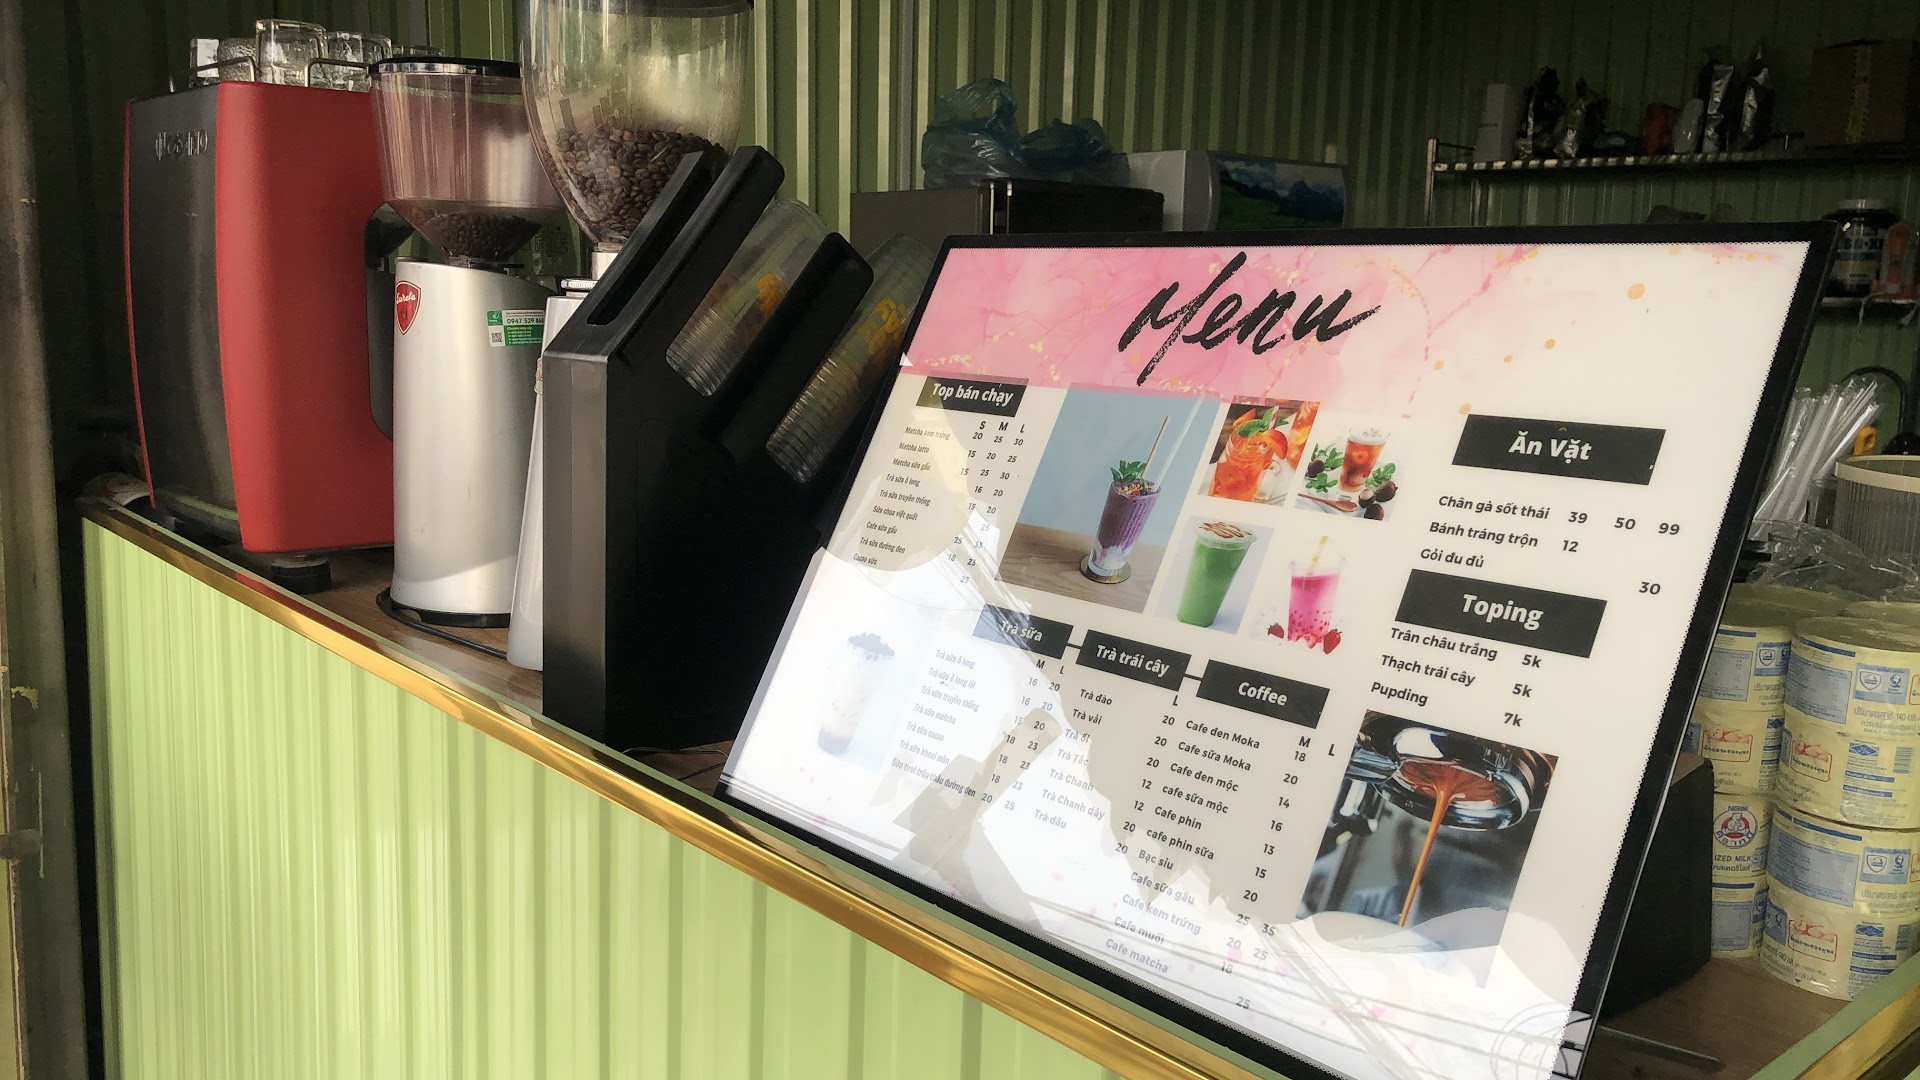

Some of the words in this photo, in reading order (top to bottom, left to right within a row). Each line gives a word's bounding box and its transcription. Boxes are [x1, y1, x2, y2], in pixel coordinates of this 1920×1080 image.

[1118, 251, 1381, 386] Menu
[931, 382, 954, 401] Top
[954, 384, 980, 400] bán
[980, 387, 1014, 407] chạy
[903, 425, 923, 436] Matcha
[971, 431, 984, 440] 20
[992, 435, 1004, 443] 25
[1012, 437, 1024, 446] 30
[978, 420, 986, 430] S
[997, 421, 1009, 431] M
[897, 441, 917, 452] Matcha
[967, 449, 977, 458] 15
[985, 451, 997, 460] 20
[1006, 454, 1017, 463] 25
[1507, 430, 1543, 456] Ăn
[1550, 438, 1592, 464] Vặt
[891, 457, 911, 468] Matcha
[959, 467, 970, 476] 15
[979, 468, 990, 477] 25
[999, 471, 1010, 480] 30
[967, 502, 976, 511] 15
[985, 505, 997, 514] 20
[973, 485, 983, 494] 16
[992, 488, 1004, 497] 20
[1438, 495, 1474, 510] Chân
[1474, 500, 1493, 514] gà
[1494, 502, 1518, 515] sốt
[1520, 505, 1551, 520] thái
[1567, 510, 1588, 524] 39
[1613, 516, 1636, 530] 50
[1657, 522, 1680, 536] 99
[1428, 521, 1465, 537] Bánh
[1466, 527, 1506, 545] tráng
[1507, 532, 1539, 548] trộn
[1562, 539, 1579, 553] 12
[1419, 547, 1444, 562] Gỏi
[1444, 551, 1463, 565] đu
[1464, 554, 1485, 568] đủ
[1638, 581, 1661, 595] 30
[1000, 619, 1019, 635] Trà
[1019, 623, 1043, 642] sữa
[1462, 593, 1544, 631] Toping
[1035, 658, 1046, 669] M
[1096, 644, 1117, 661] Trà
[1118, 651, 1145, 668] trái
[1144, 658, 1170, 678] cây
[1390, 627, 1420, 643] Trân
[1421, 634, 1456, 651] châu
[1521, 653, 1542, 669] 5k
[1027, 676, 1038, 687] 16
[1047, 681, 1061, 692] 20
[1237, 681, 1287, 706] Coffee
[1381, 654, 1421, 673] Thạch
[1423, 663, 1449, 679] trái
[1449, 670, 1476, 687] cây
[1511, 682, 1532, 698] 5k
[1020, 695, 1031, 706] 16
[1040, 700, 1053, 711] 20
[1079, 688, 1094, 701] Trà
[1094, 693, 1113, 706] đào
[1161, 714, 1175, 726] 20
[1370, 681, 1428, 707] Pupding
[1503, 711, 1523, 727] 7k
[1005, 733, 1016, 745] 18
[1026, 740, 1039, 751] 23
[1013, 715, 1023, 726] 15
[1032, 720, 1045, 731] 20
[1072, 708, 1086, 720] Trà
[1087, 713, 1103, 725] vải
[1153, 735, 1168, 747] 20
[1185, 719, 1208, 734] Cafe
[1209, 726, 1230, 740] đen
[1230, 732, 1260, 749] Moka
[1293, 750, 1306, 762] 18
[1297, 735, 1311, 748] M
[998, 753, 1008, 764] 18
[1019, 760, 1031, 771] 23
[1064, 728, 1079, 741] Trà
[1145, 756, 1160, 768] 20
[1177, 741, 1200, 755] Cafe
[1201, 749, 1221, 762] sữa
[1222, 754, 1251, 771] Moka
[1282, 772, 1298, 785] 20
[990, 773, 1001, 784] 18
[1057, 747, 1072, 761] Trà
[1141, 778, 1152, 790] 12
[1169, 762, 1193, 777] Cafe
[1193, 770, 1214, 784] đen
[1214, 778, 1239, 792] mộc
[1277, 796, 1290, 809] 14
[980, 792, 993, 804] 20
[1049, 767, 1064, 781] Trà
[1064, 774, 1094, 792] Chanh
[1133, 799, 1144, 812] 12
[1161, 785, 1183, 799] cafe
[1184, 792, 1204, 806] sữa
[1204, 799, 1229, 814] mộc
[1269, 819, 1283, 832] 16
[1041, 788, 1056, 802] Trà
[1056, 794, 1086, 813] Chanh
[1086, 805, 1106, 821] dây
[1122, 820, 1136, 833] 20
[1033, 808, 1049, 822] Trà
[1048, 815, 1067, 829] dâu
[1114, 842, 1128, 854] 20
[1154, 805, 1177, 821] Cafe
[1176, 815, 1202, 830] phin
[1262, 843, 1275, 855] 13
[1145, 829, 1168, 842] cafe
[1167, 837, 1193, 852] phin
[1193, 846, 1214, 860] sữa
[1254, 866, 1267, 879] 15
[1137, 849, 1157, 864] Bạc
[1242, 889, 1258, 903] 20
[1130, 871, 1152, 888] Cafe
[1153, 882, 1173, 896] sữa
[1235, 913, 1250, 926] 25
[1261, 922, 1276, 937] 35
[1113, 916, 1136, 933] Cafe
[1121, 893, 1144, 910] Cafe
[1144, 900, 1169, 921] kem
[1170, 913, 1202, 936] trứng
[1225, 936, 1242, 950] 20
[1252, 947, 1268, 961] 25
[1105, 938, 1128, 955] Cafe
[1128, 950, 1169, 974] matcha
[1234, 996, 1251, 1010] 25
